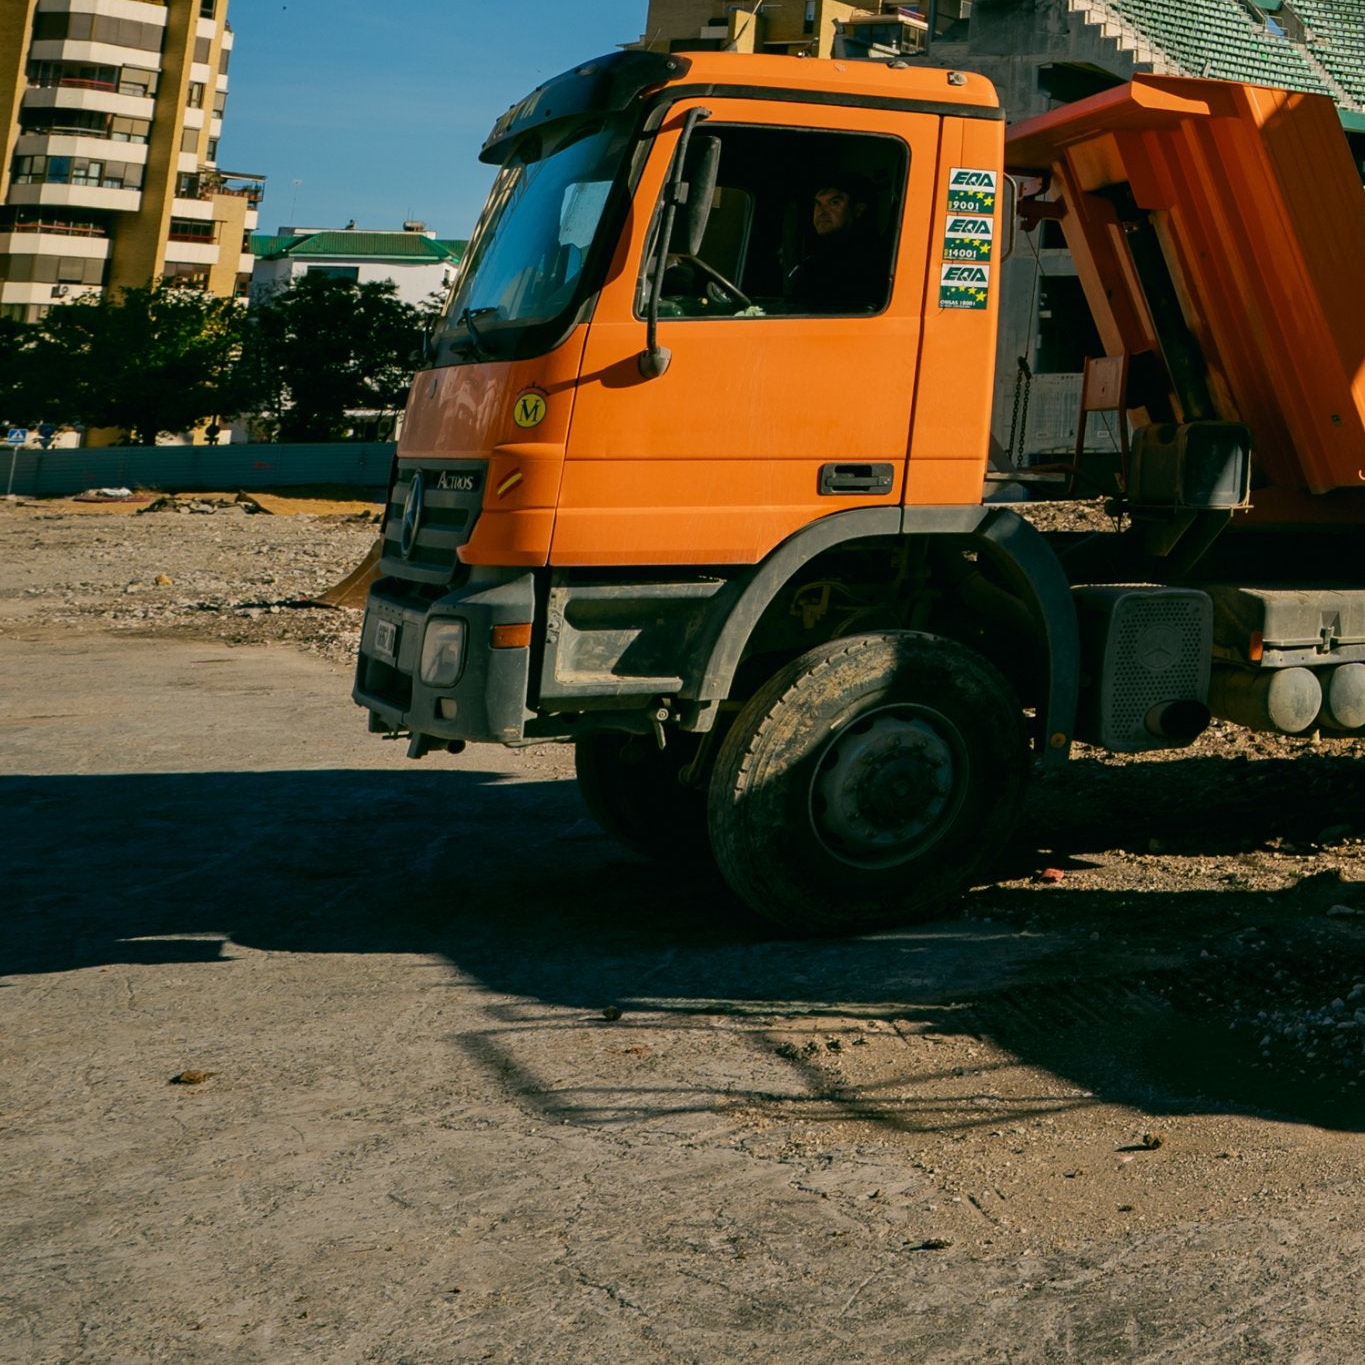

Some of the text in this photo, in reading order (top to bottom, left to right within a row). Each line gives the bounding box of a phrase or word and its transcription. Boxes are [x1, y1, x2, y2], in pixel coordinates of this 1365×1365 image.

[951, 171, 994, 188] EQA
[953, 200, 979, 211] 9001
[947, 219, 991, 234] EQA
[949, 249, 977, 258] 14001
[943, 267, 987, 282] EQA
[519, 399, 541, 423] M
